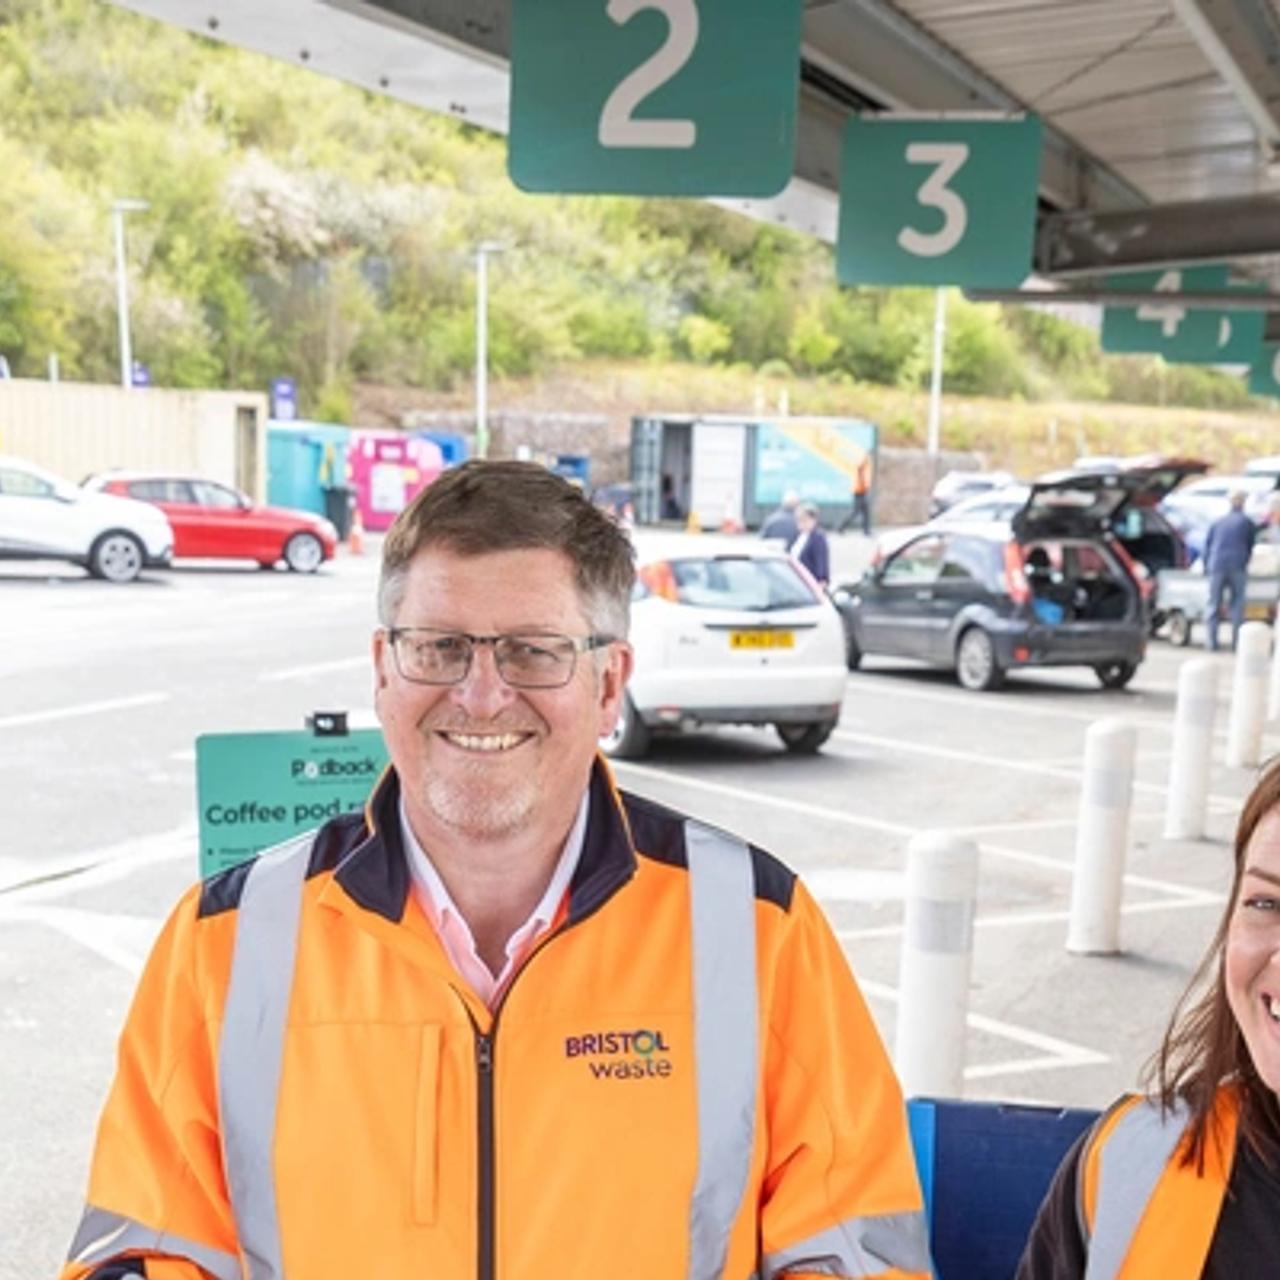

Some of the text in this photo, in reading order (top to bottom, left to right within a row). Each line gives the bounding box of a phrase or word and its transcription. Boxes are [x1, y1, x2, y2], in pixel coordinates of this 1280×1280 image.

[598, 0, 699, 148] 2
[897, 142, 969, 257] 3
[1136, 271, 1186, 338] 4
[205, 797, 341, 826] Coffee pod
[565, 1028, 670, 1058] BRISTOL
[589, 1057, 672, 1079] waste
